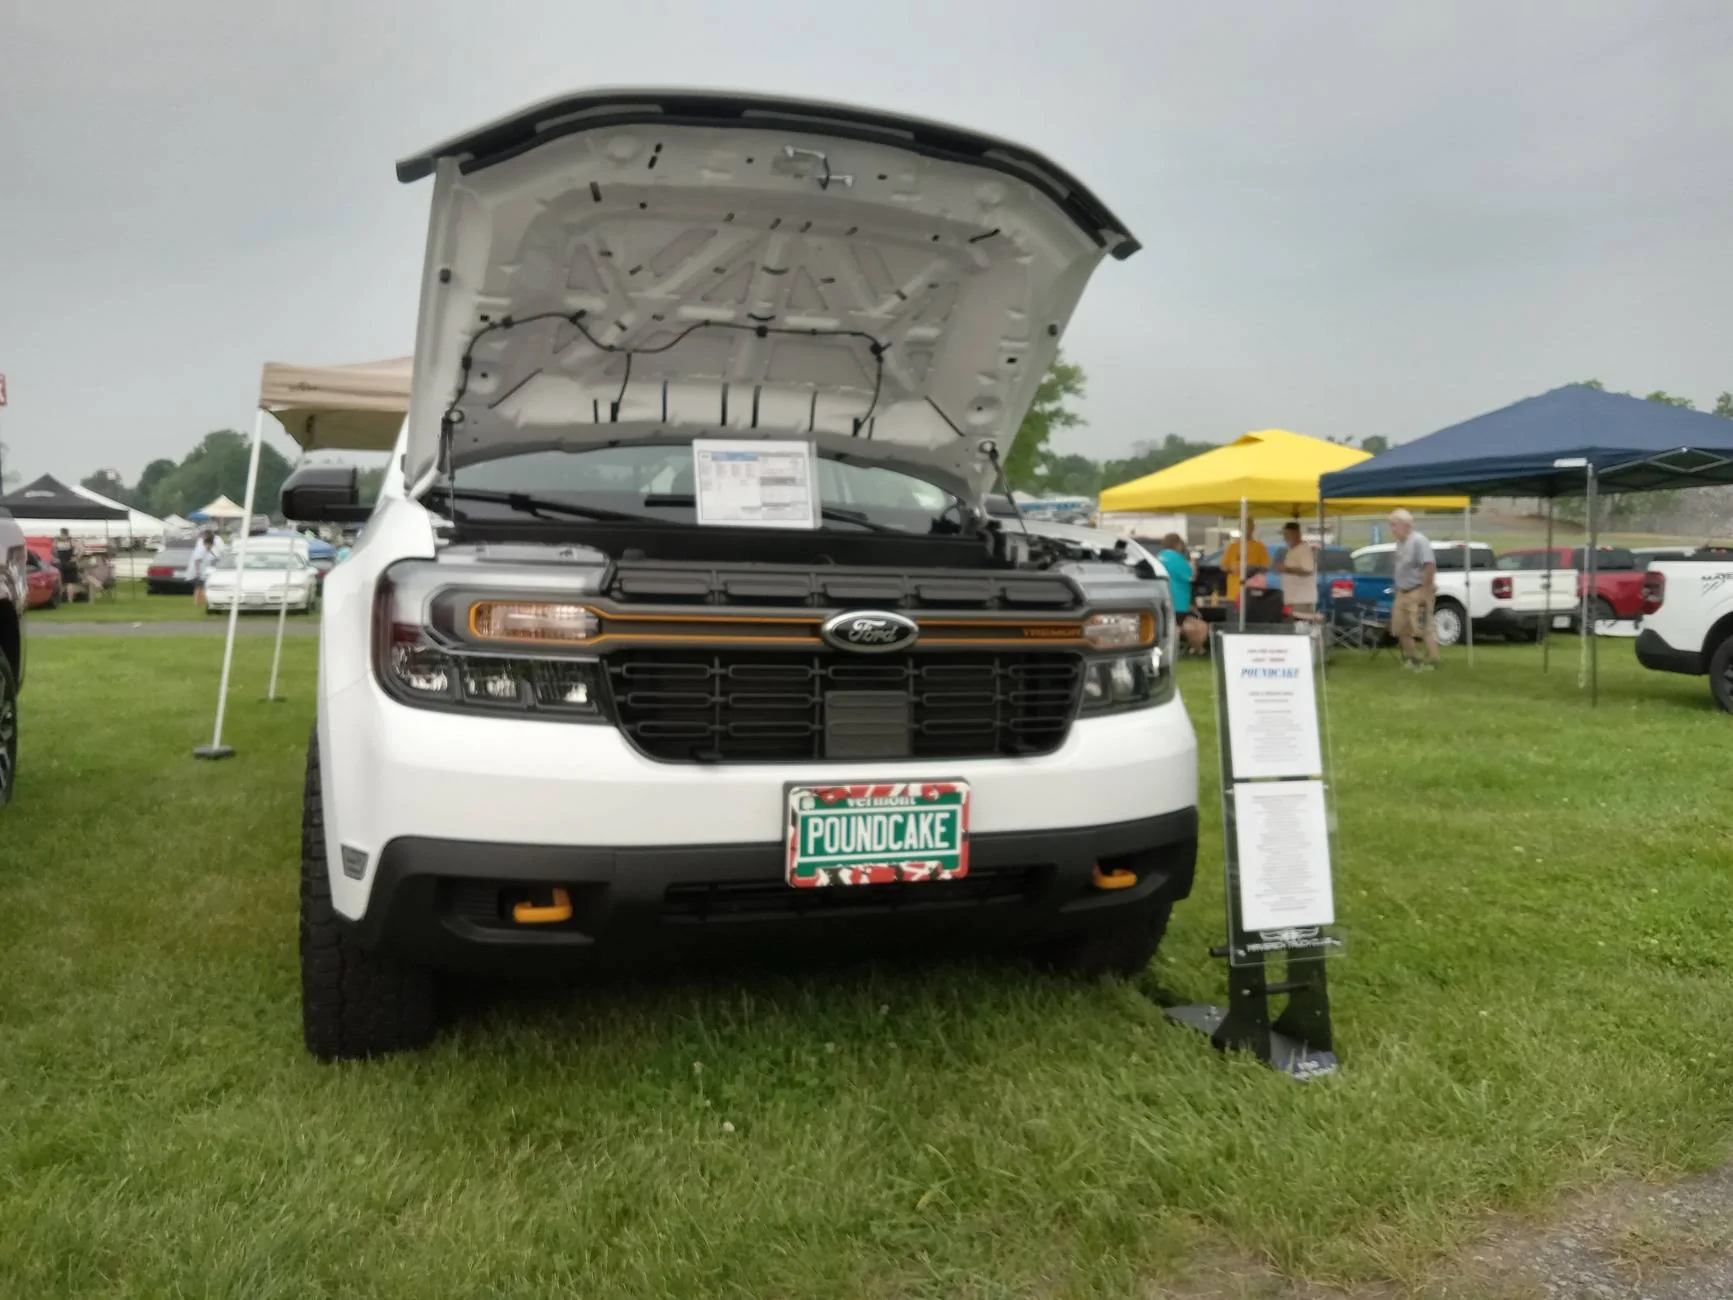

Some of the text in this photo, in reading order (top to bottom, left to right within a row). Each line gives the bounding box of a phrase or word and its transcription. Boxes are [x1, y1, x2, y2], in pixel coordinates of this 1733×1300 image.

[848, 619, 899, 642] Ford
[1022, 628, 1081, 637] TREMOR
[806, 812, 951, 855] POUNDCAKE
